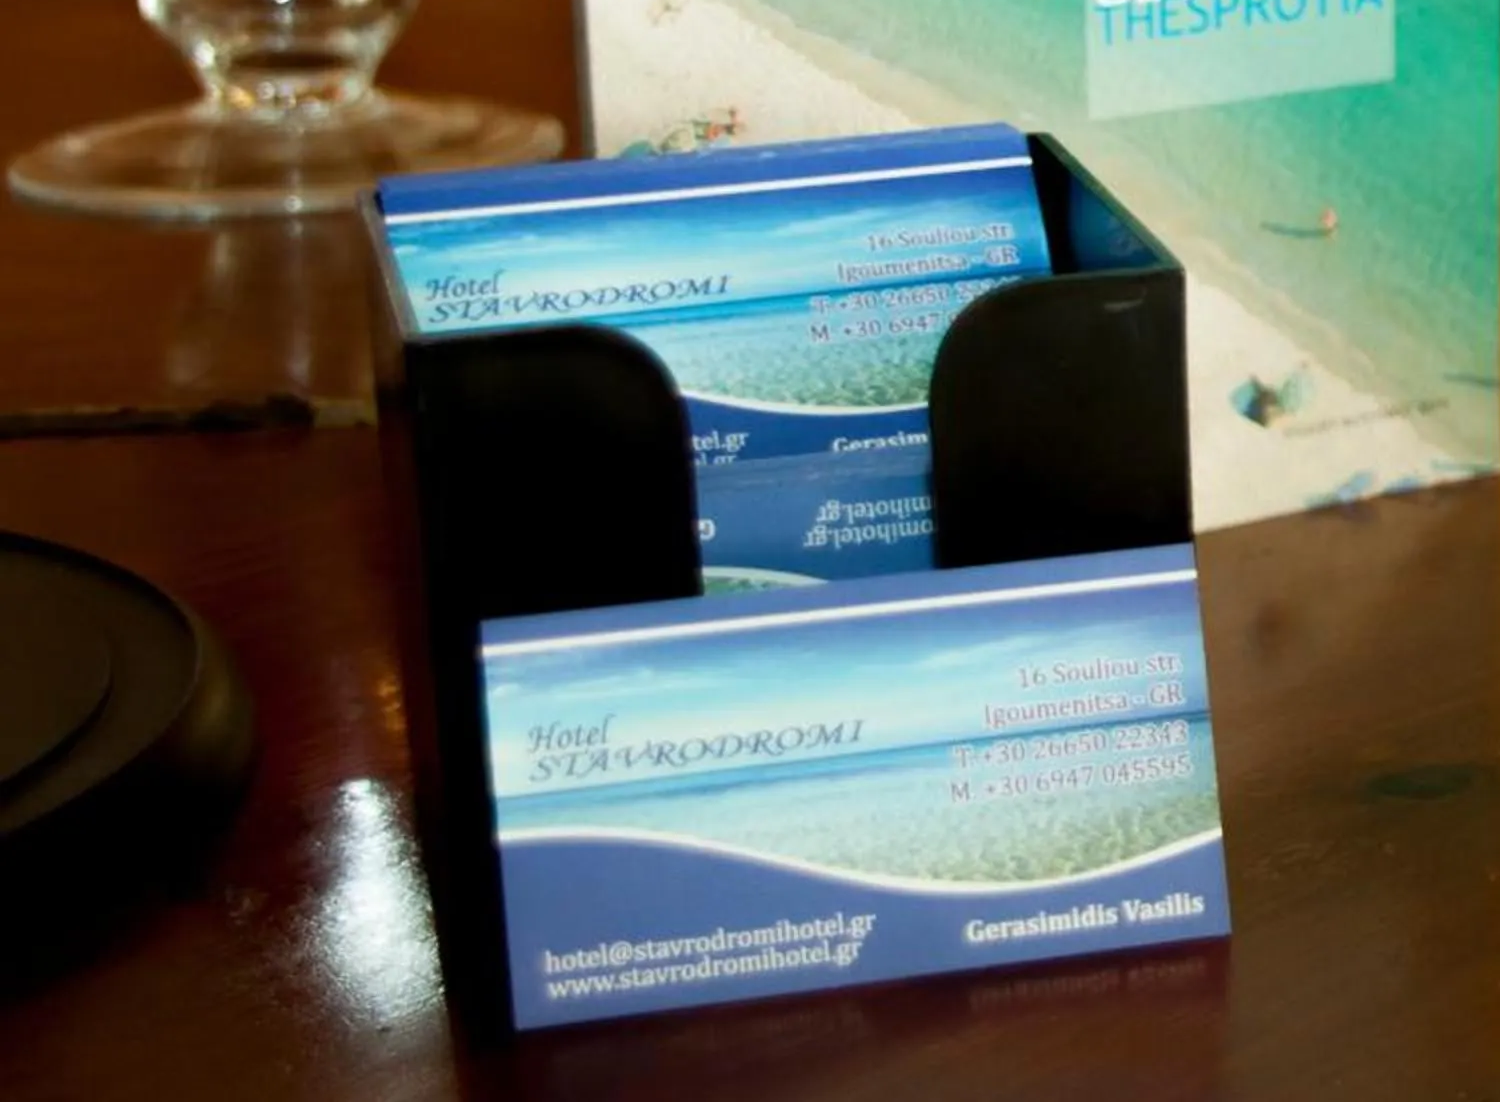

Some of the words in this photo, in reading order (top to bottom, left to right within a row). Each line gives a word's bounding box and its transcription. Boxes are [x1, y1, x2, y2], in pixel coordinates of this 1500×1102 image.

[426, 269, 505, 301] Hotel
[428, 275, 732, 323] STAVRODROMI
[1019, 666, 1046, 688] 16
[1052, 658, 1139, 685] Souliou
[984, 695, 1128, 727] Igoumenitsa
[1149, 682, 1183, 705] GR
[528, 713, 615, 755] Hotel
[528, 719, 866, 783] STAVRODROMI
[983, 741, 1026, 765] +30
[1033, 732, 1107, 760] 26650
[1115, 721, 1188, 750] 22343
[985, 775, 1029, 798] +30
[1035, 765, 1094, 792] 6947
[1102, 754, 1192, 785] 045595
[966, 902, 1118, 942] Gerasimidis
[1121, 892, 1206, 923] Vasilis
[545, 911, 876, 974] hotel@stavrodromihotel.gr
[546, 939, 864, 999] www.stavrodromihotel.gr
